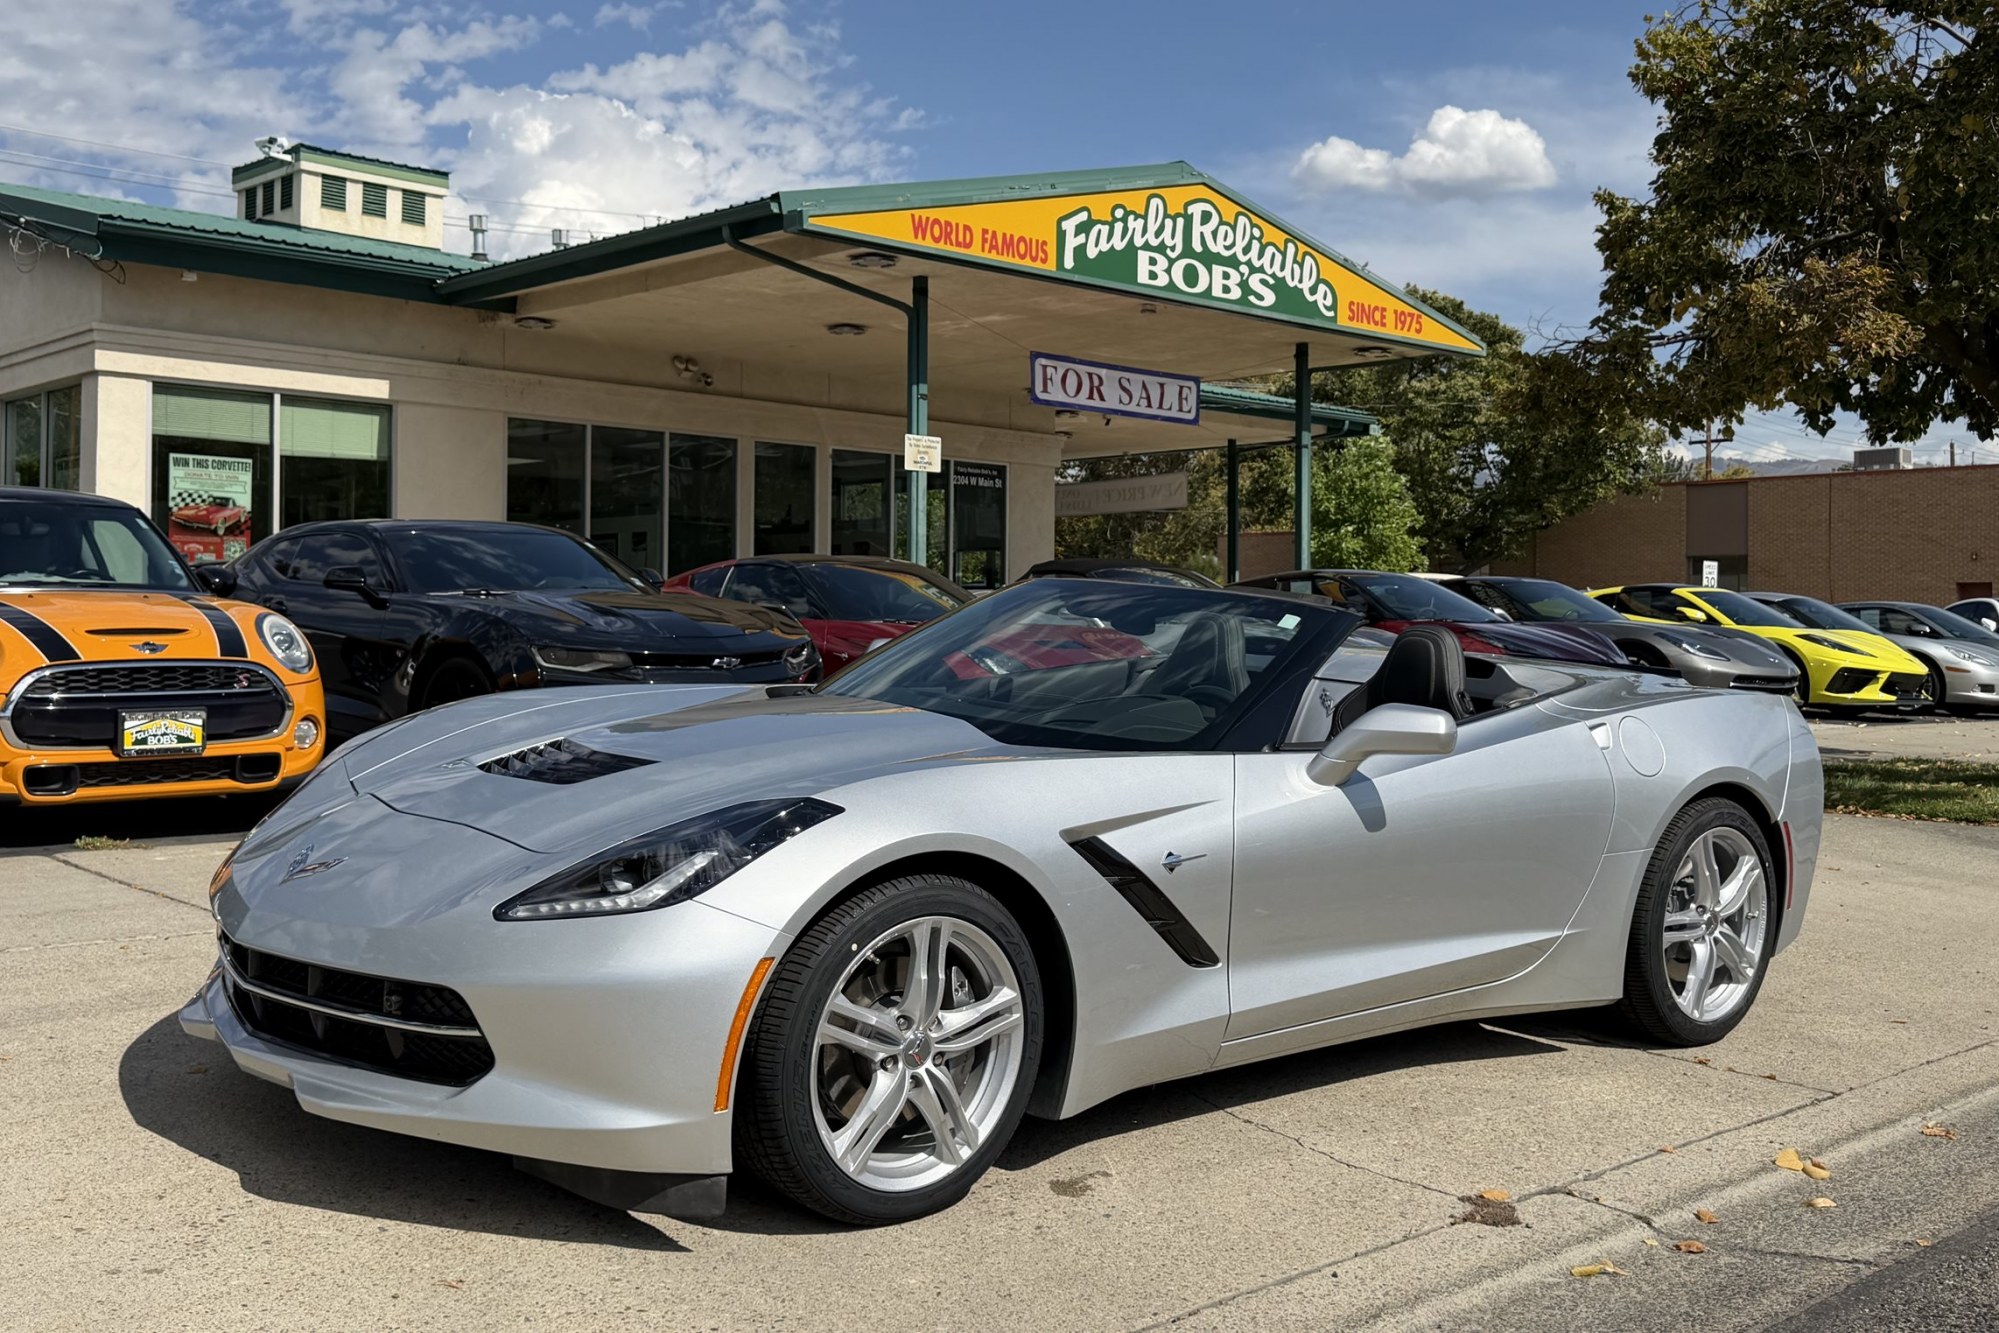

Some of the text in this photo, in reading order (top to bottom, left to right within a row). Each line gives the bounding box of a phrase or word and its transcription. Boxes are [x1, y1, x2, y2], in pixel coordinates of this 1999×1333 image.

[910, 212, 1048, 264] WORLD FAMOUS
[1061, 197, 1336, 317] Fairly Reliable
[1137, 249, 1276, 307] BOB'S
[1347, 300, 1423, 334] SINCE 1975
[1039, 363, 1192, 414] FOR SALE
[172, 456, 251, 473] WIN THIS CORVETTE!
[952, 474, 1003, 488] 2304 W Main St
[1704, 576, 1716, 588] 30
[147, 734, 178, 745] BOB'S
